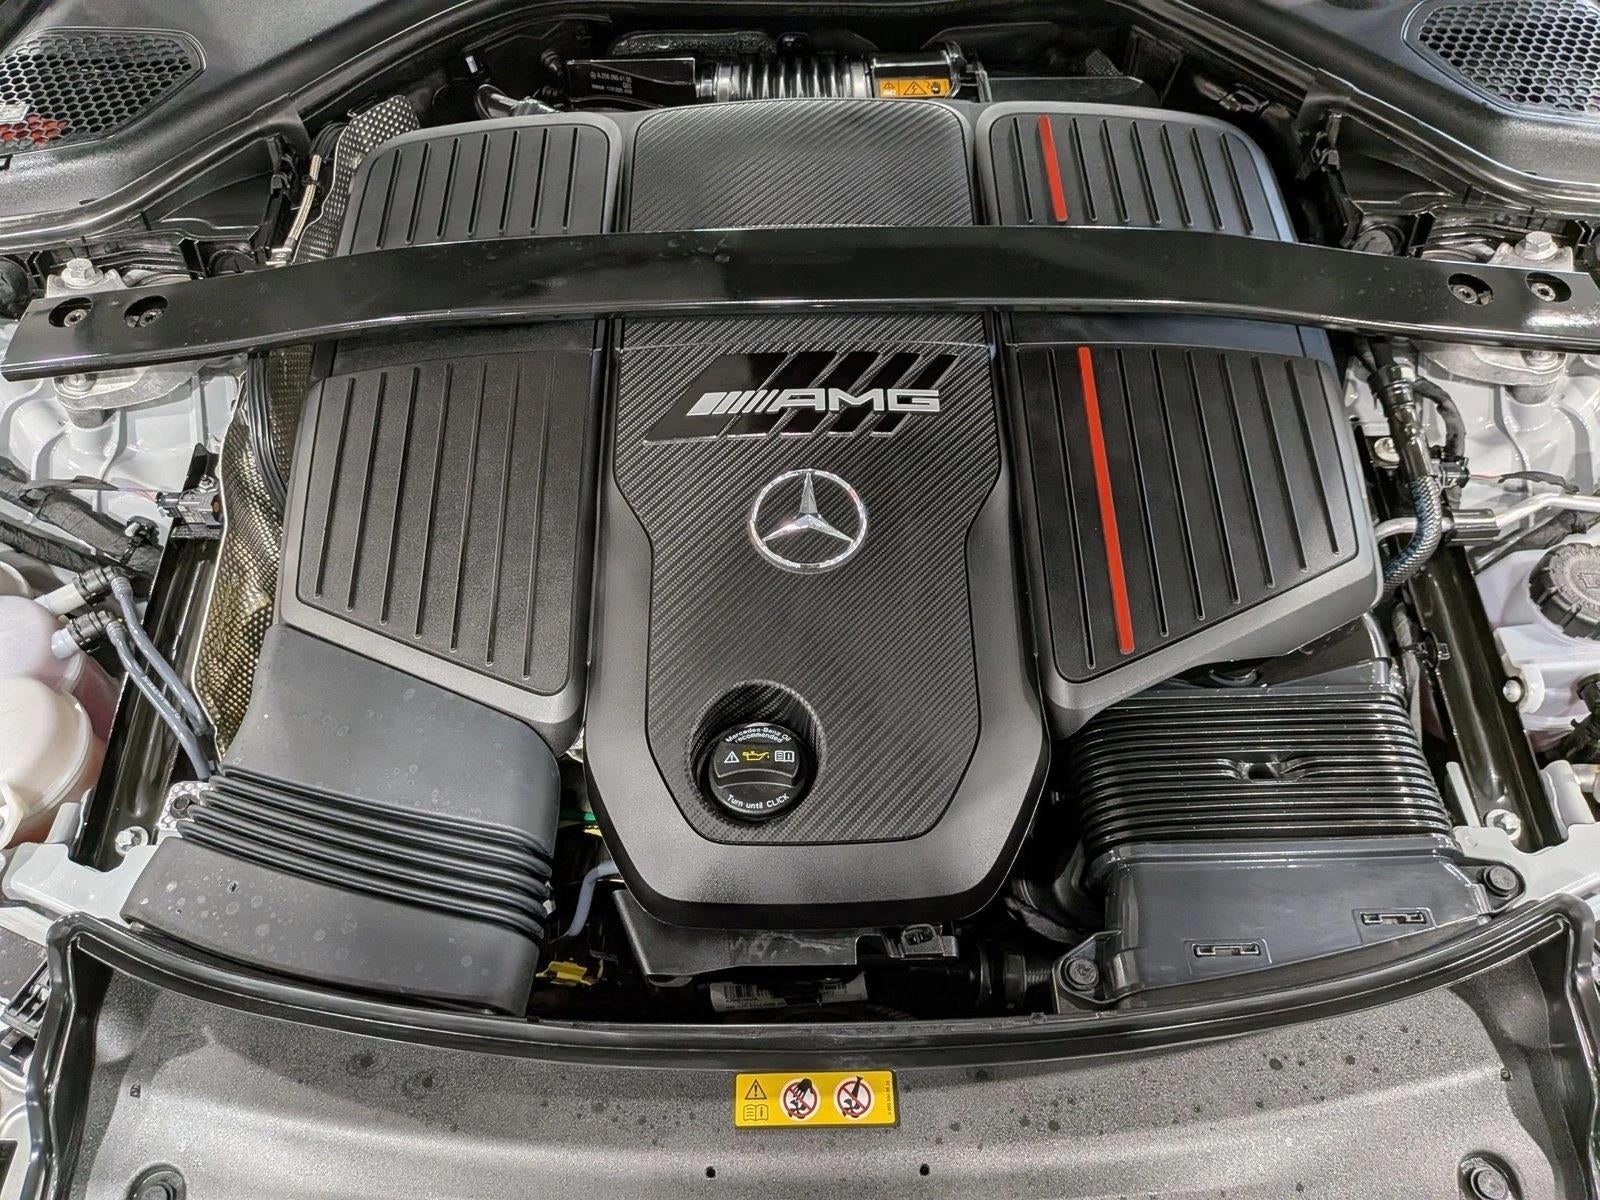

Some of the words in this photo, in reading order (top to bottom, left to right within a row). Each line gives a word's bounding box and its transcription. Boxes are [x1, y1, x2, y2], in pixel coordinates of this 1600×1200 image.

[767, 388, 940, 412] AMG
[734, 732, 783, 743] recommended
[781, 733, 792, 742] Oil
[727, 794, 744, 807] Turn
[766, 793, 790, 808] CLICK
